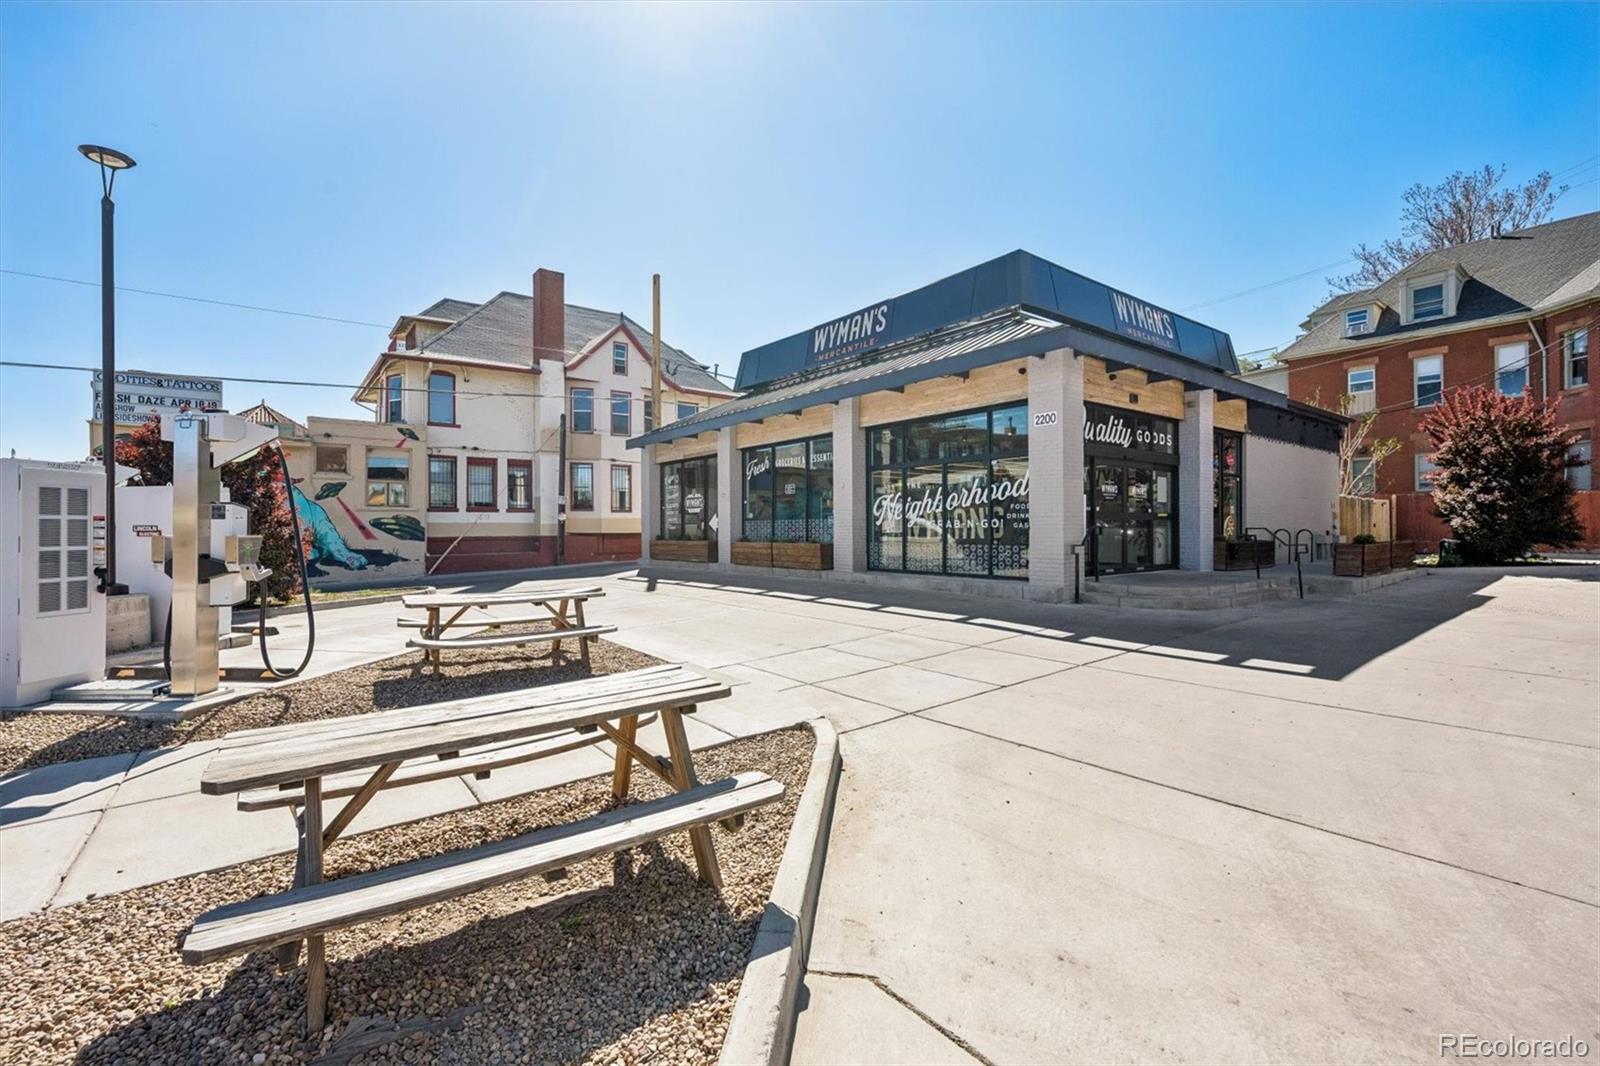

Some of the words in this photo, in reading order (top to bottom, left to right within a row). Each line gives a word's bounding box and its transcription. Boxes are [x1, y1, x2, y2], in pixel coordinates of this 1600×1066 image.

[814, 305, 888, 353] WYMAN'S
[1113, 292, 1174, 339] WYMAN'S
[138, 395, 166, 406] DAZE
[1034, 413, 1057, 426] 2200
[1084, 411, 1133, 448] uality
[1136, 430, 1173, 446] GOODS
[746, 456, 770, 480] Fresh
[873, 470, 1030, 528] Neighborhood
